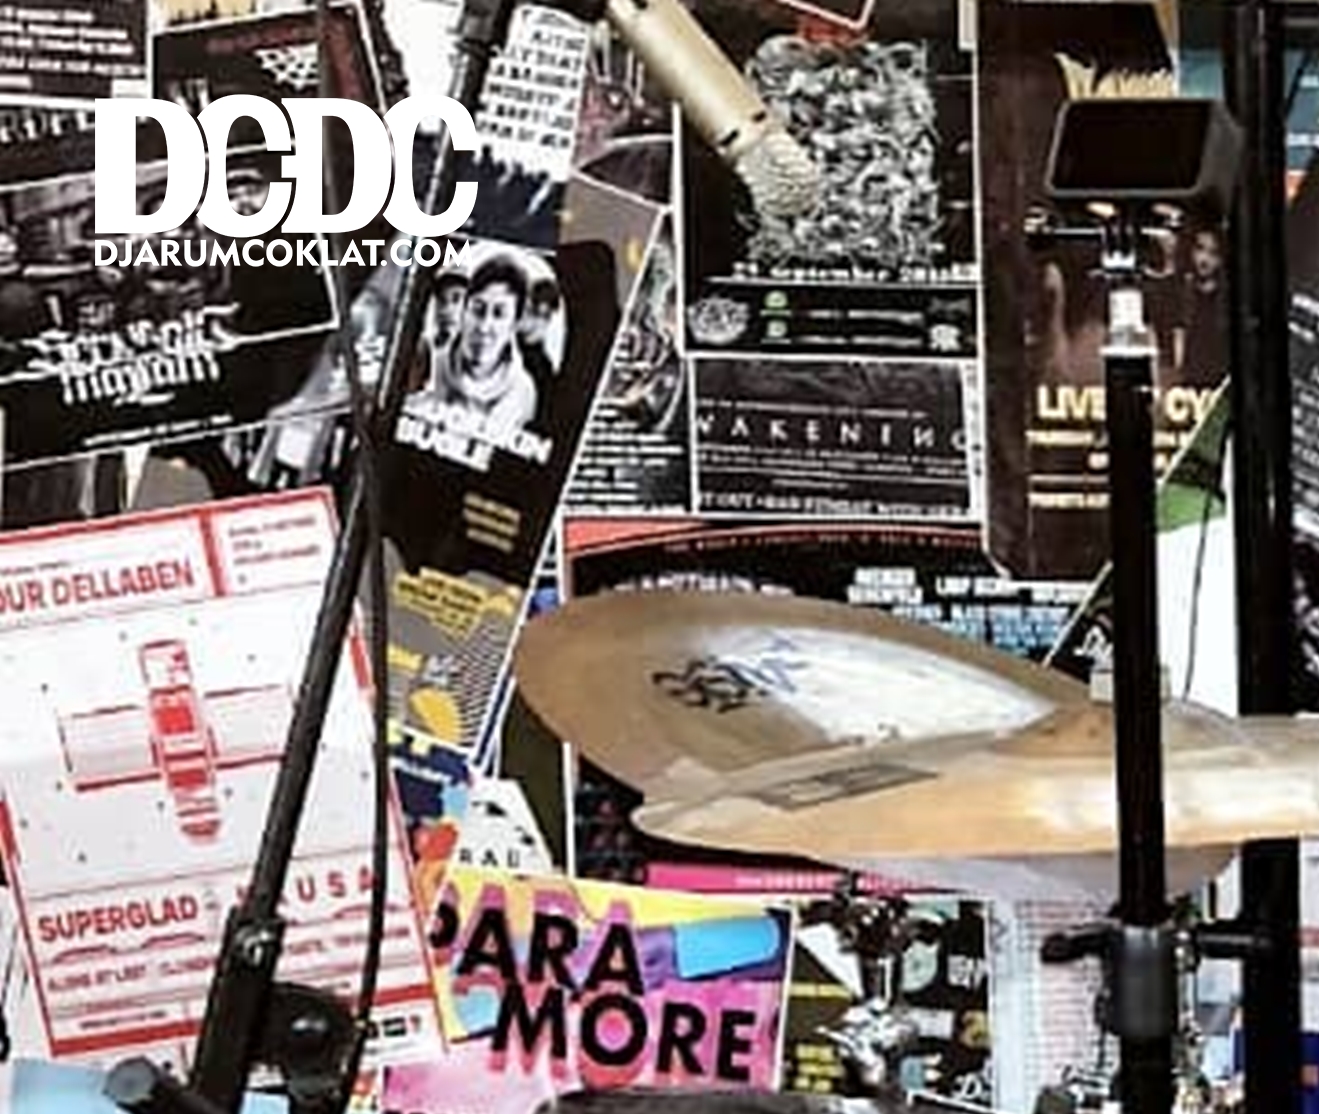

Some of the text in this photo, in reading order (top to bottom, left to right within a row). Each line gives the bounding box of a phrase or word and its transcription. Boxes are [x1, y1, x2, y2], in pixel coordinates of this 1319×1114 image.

[38, 896, 199, 943] SUPERGLAD
[428, 900, 645, 997] PARA
[491, 985, 757, 1082] MORE
